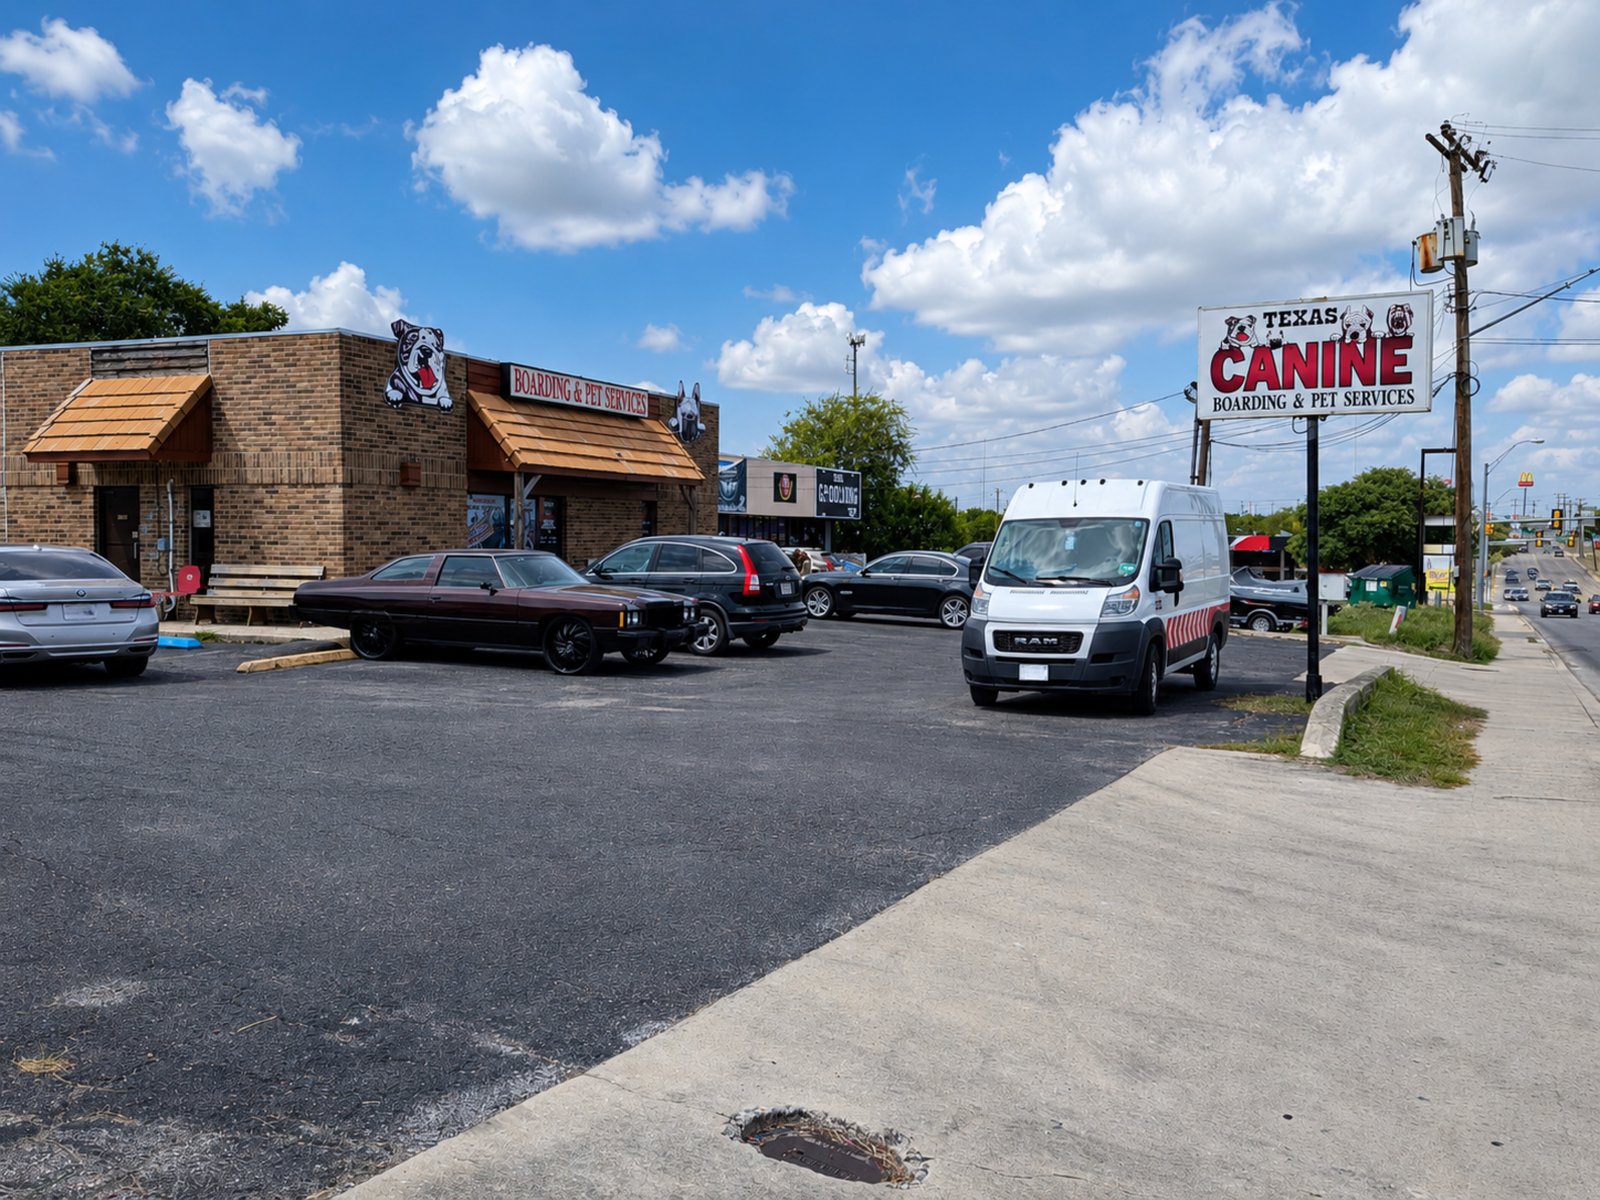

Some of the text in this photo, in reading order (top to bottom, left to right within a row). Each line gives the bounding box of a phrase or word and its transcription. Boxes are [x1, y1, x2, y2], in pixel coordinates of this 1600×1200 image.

[1263, 307, 1338, 328] TEXAS
[1210, 336, 1413, 394] CANINE
[514, 368, 647, 414] BOARDING & PET SERVICES
[1213, 389, 1415, 412] BOARDING & PET SERVICES
[1014, 637, 1058, 645] RAM
